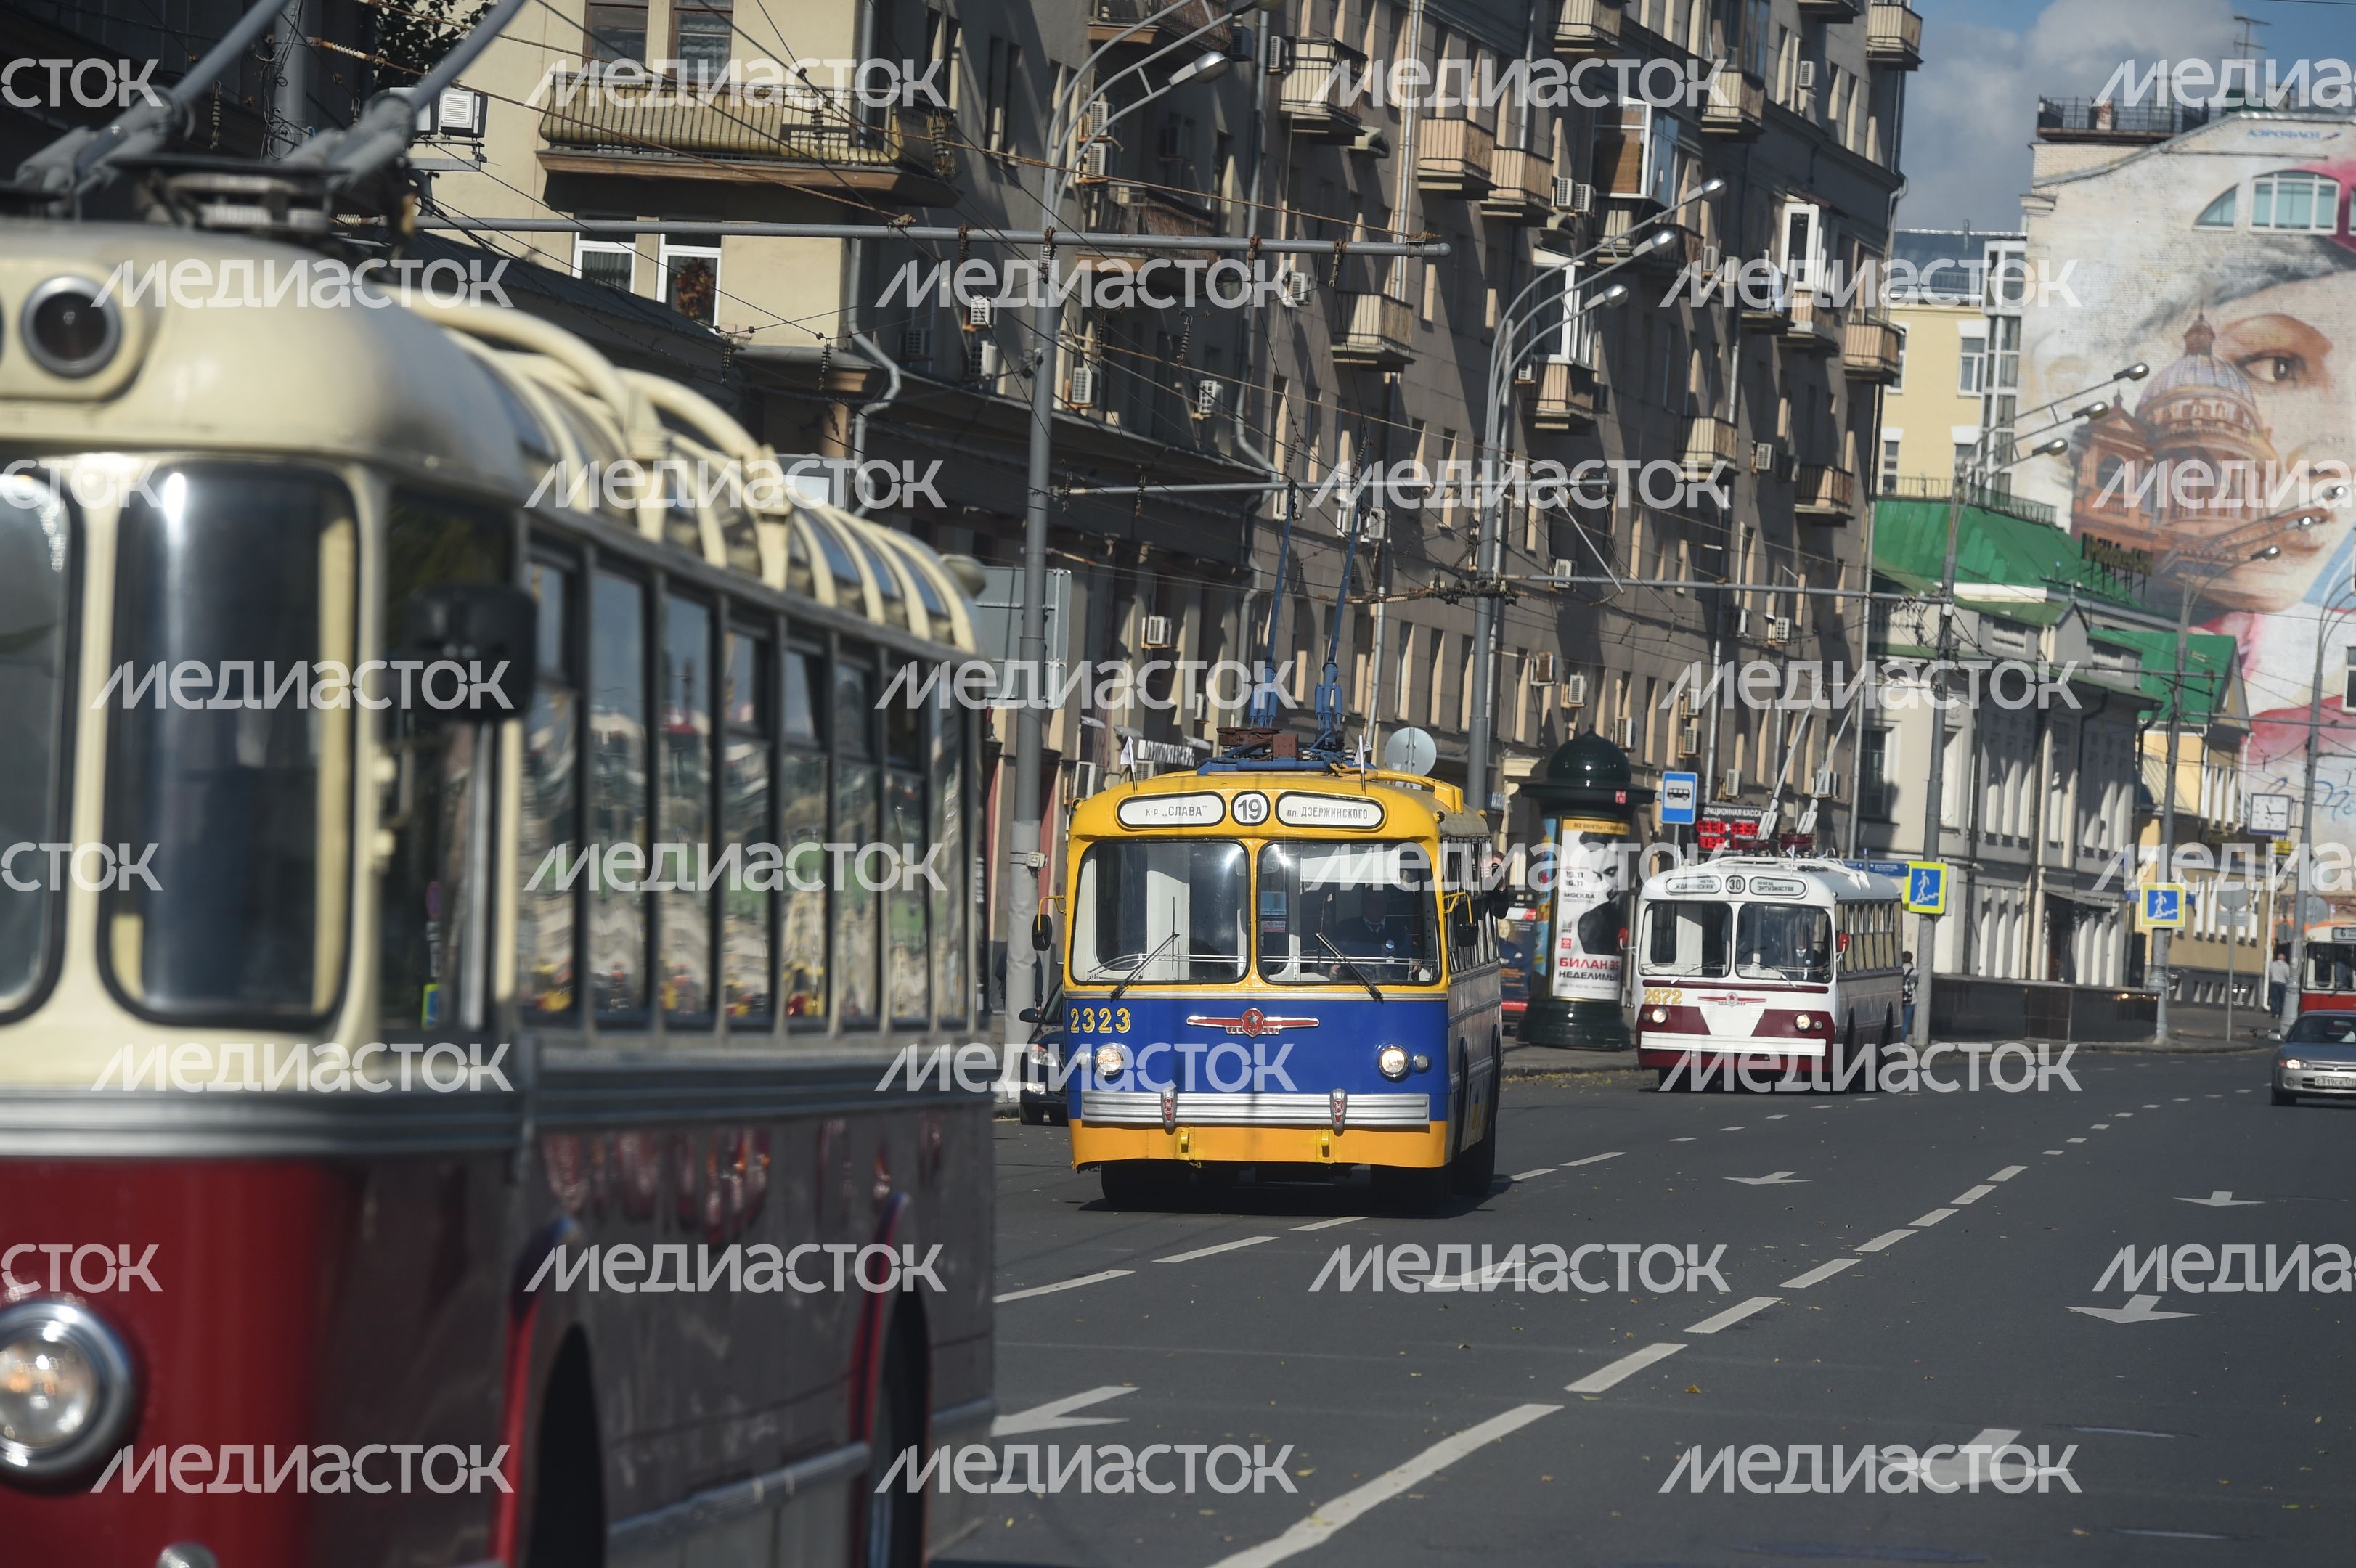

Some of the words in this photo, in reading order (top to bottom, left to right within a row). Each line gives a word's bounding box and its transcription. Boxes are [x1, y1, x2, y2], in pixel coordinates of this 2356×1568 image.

[1238, 799, 1262, 820] 19
[1301, 807, 1368, 819] ДЗЕРЖИНСКОГО
[1729, 879, 1742, 891] 30
[1560, 957, 1607, 969] БИЛАН
[1644, 988, 1682, 1005] 2672
[1070, 1008, 1131, 1033] 2323
